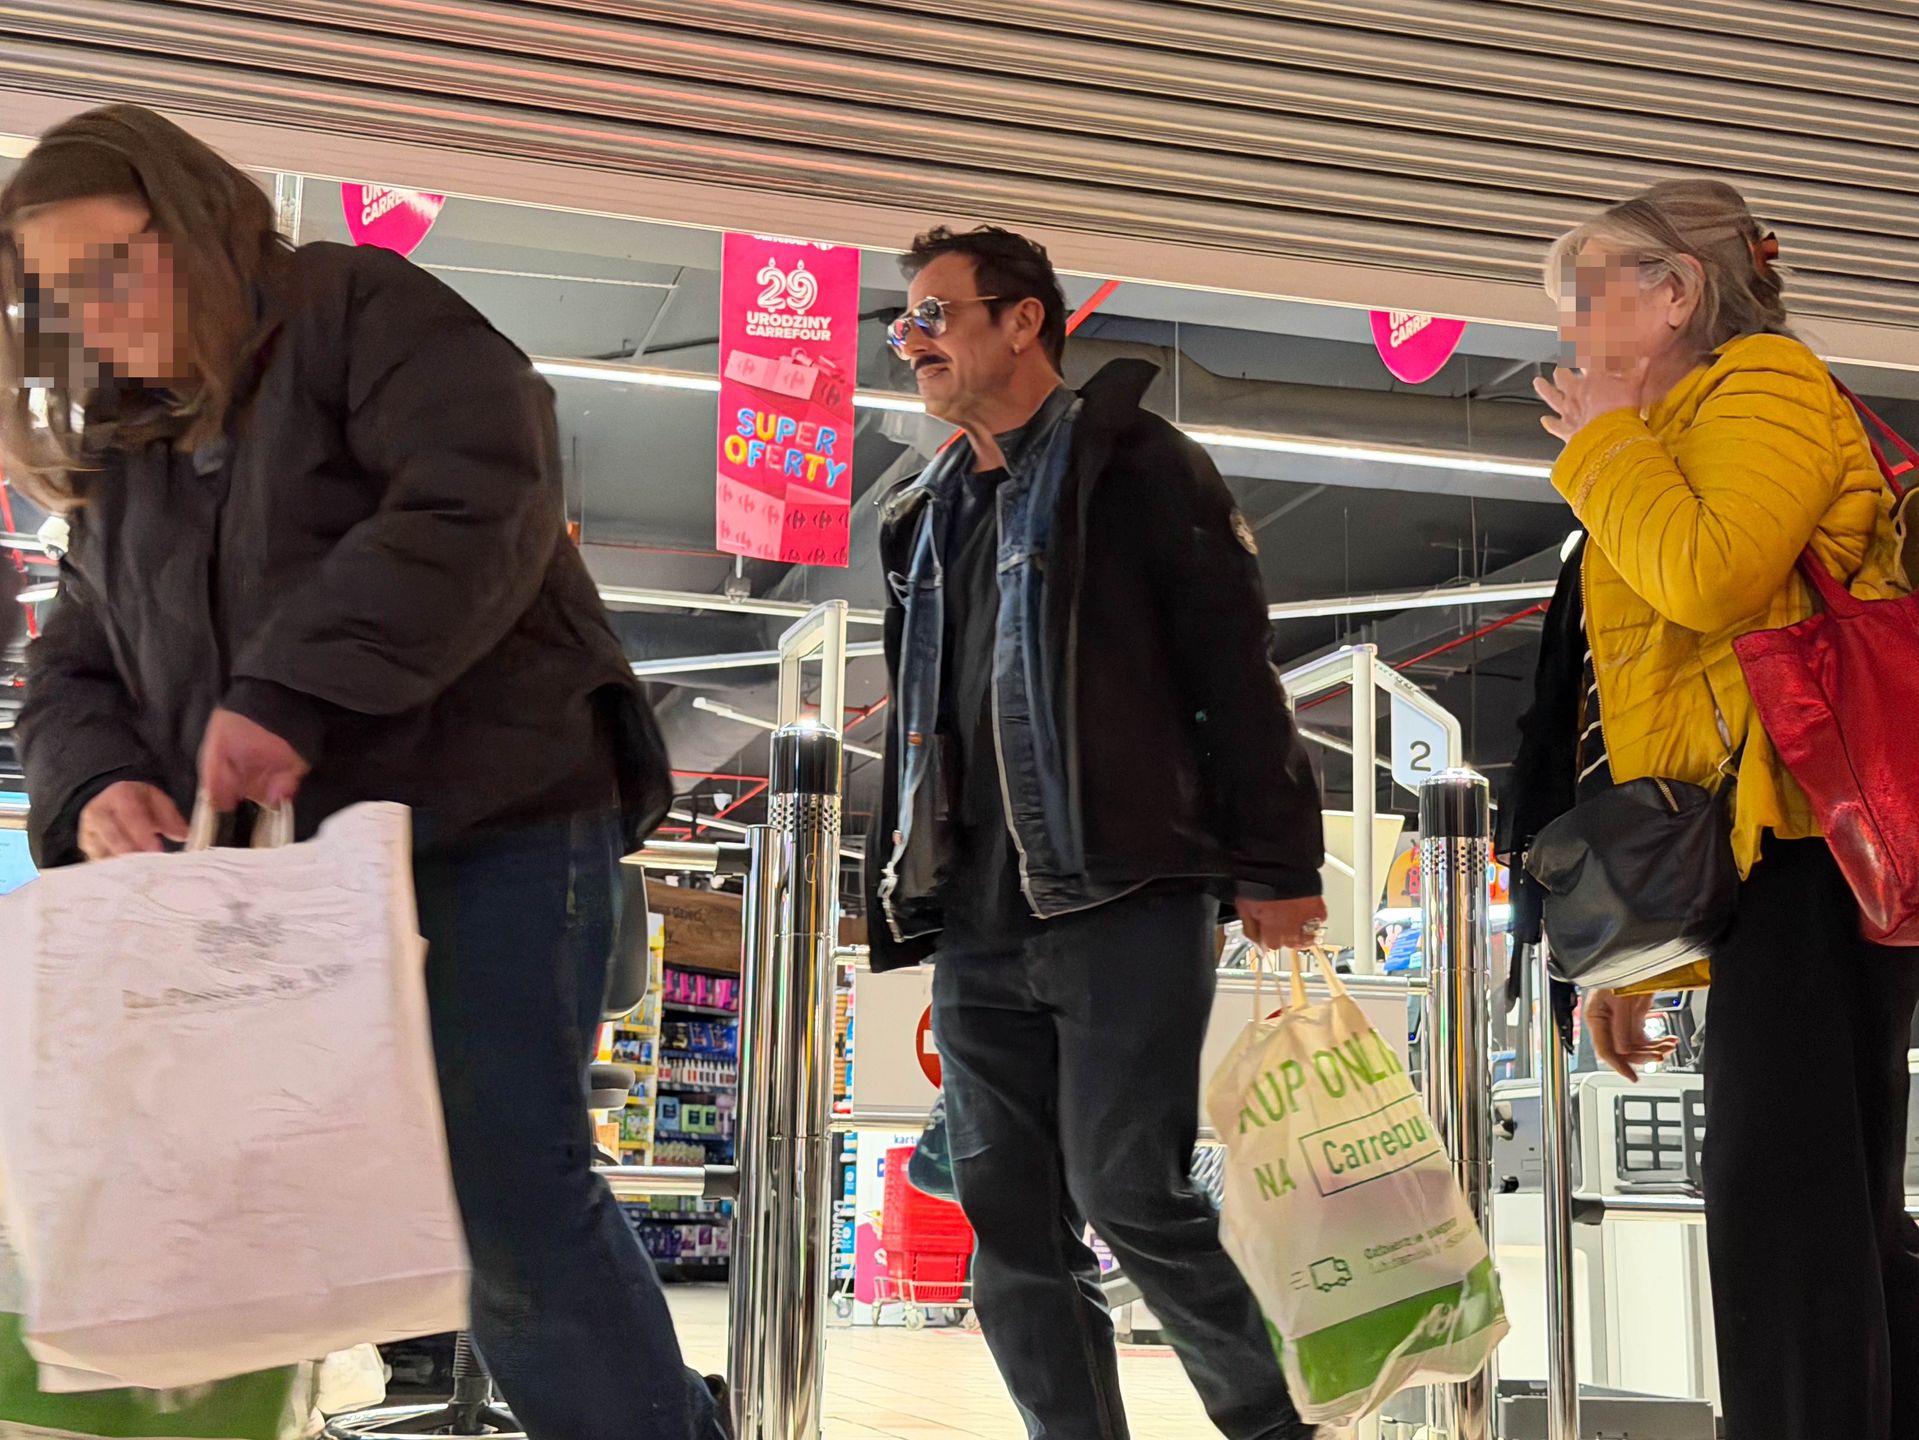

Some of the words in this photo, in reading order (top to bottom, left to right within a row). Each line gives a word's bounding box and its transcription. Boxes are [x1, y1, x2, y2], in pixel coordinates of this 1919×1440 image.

[756, 258, 818, 314] 29
[745, 324, 831, 341] CARREFOUR
[746, 310, 832, 329] URODZINY
[736, 407, 837, 455] SUPER
[724, 434, 847, 487] OFERTY
[1409, 740, 1431, 772] 2
[1254, 1157, 1297, 1201] NA
